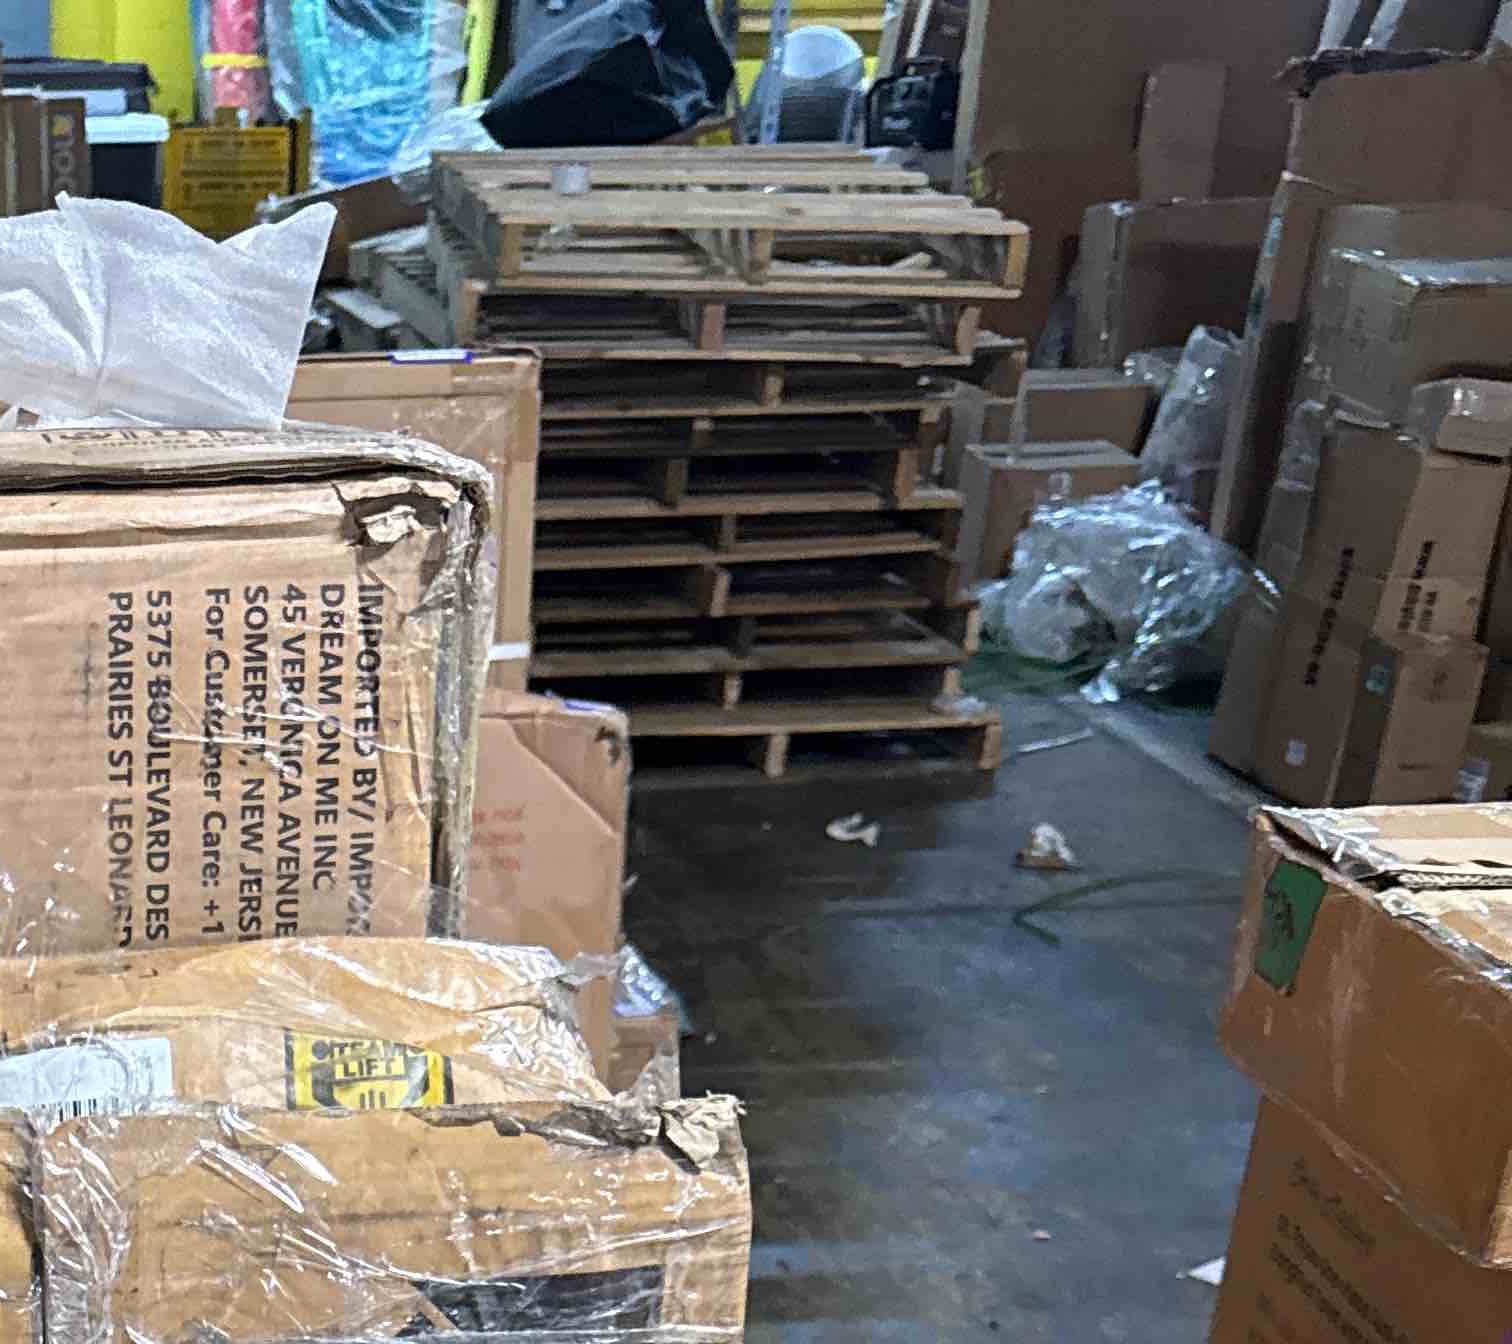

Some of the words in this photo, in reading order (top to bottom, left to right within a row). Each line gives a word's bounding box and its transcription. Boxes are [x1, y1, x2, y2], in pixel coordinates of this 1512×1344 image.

[146, 589, 172, 667] 5375
[204, 587, 231, 642] For
[281, 583, 307, 625] 45
[107, 591, 134, 741] PRAIRIES
[317, 583, 346, 706] DREAM
[353, 583, 385, 759] IMPORTED
[202, 649, 231, 802] Customer
[279, 631, 306, 804] VERONICA
[317, 714, 342, 766] ON
[107, 749, 133, 787] ST
[145, 675, 172, 874] BOULEVARD
[314, 776, 340, 827] ME
[200, 810, 227, 889] Care:
[238, 777, 266, 858] NEW
[274, 812, 303, 938] AVENUE
[312, 833, 339, 891] INC
[145, 883, 171, 941] DES
[200, 899, 225, 935] +1
[343, 1057, 397, 1078] LIFT
